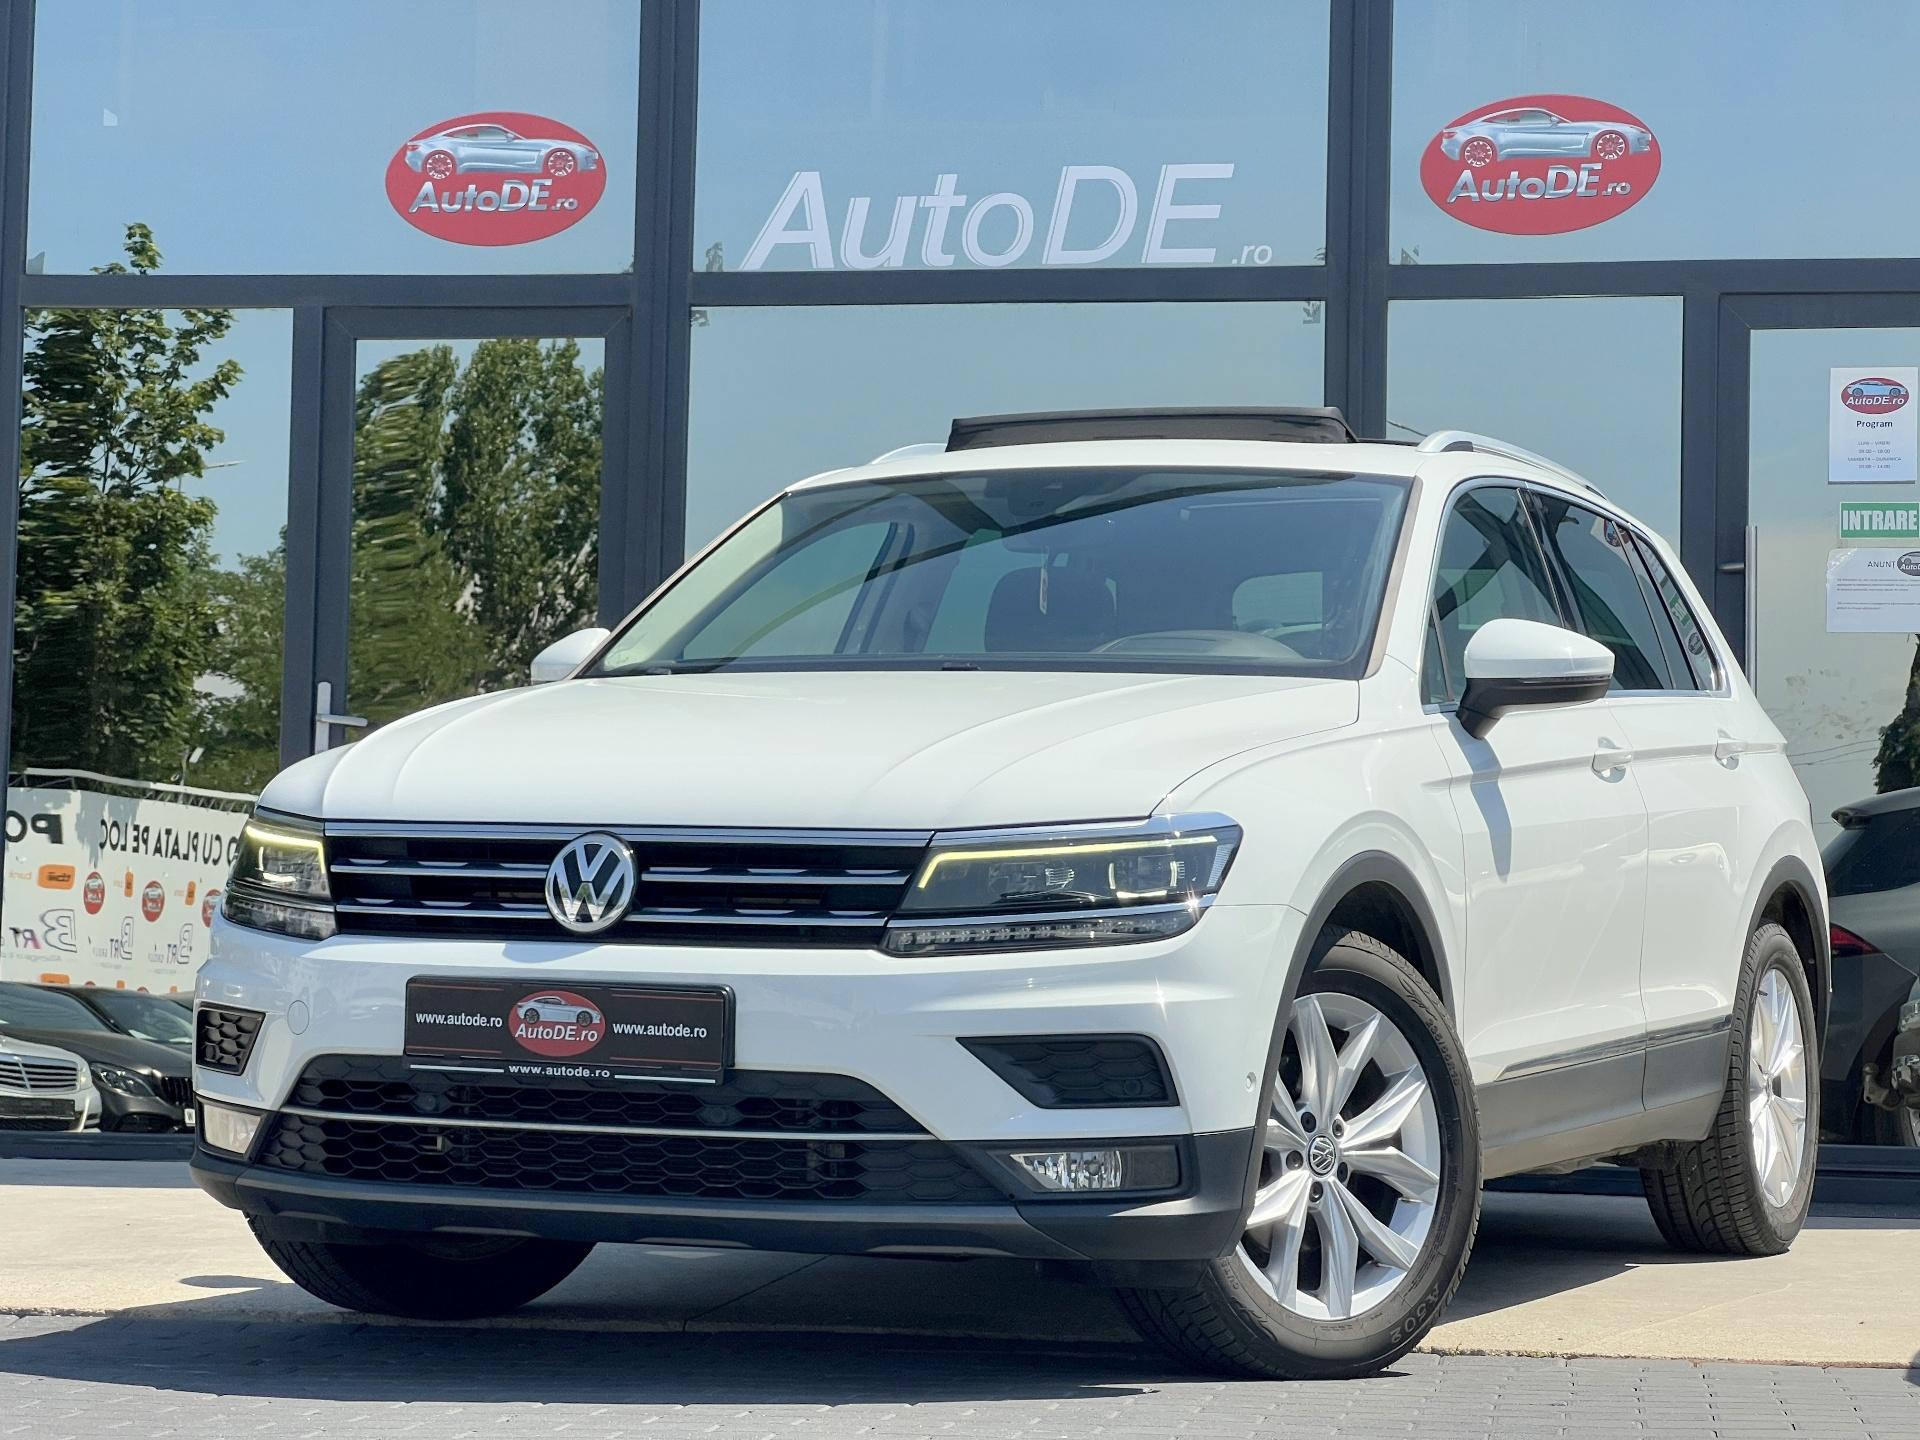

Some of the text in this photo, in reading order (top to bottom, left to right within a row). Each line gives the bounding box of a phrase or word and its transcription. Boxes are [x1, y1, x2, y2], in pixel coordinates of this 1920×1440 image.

[1447, 162, 1632, 204] AutoDE.ro
[408, 178, 579, 214] AutoDE.ro
[1846, 396, 1905, 405] AutoDE.ro
[1856, 420, 1893, 429] Program
[1842, 510, 1918, 531] INTRARE
[415, 1012, 503, 1028] www.autode.ro
[514, 1023, 599, 1042] AutoDE.ro
[612, 1022, 707, 1038] www.autode.ro
[508, 1064, 610, 1078] www.autode.ro
